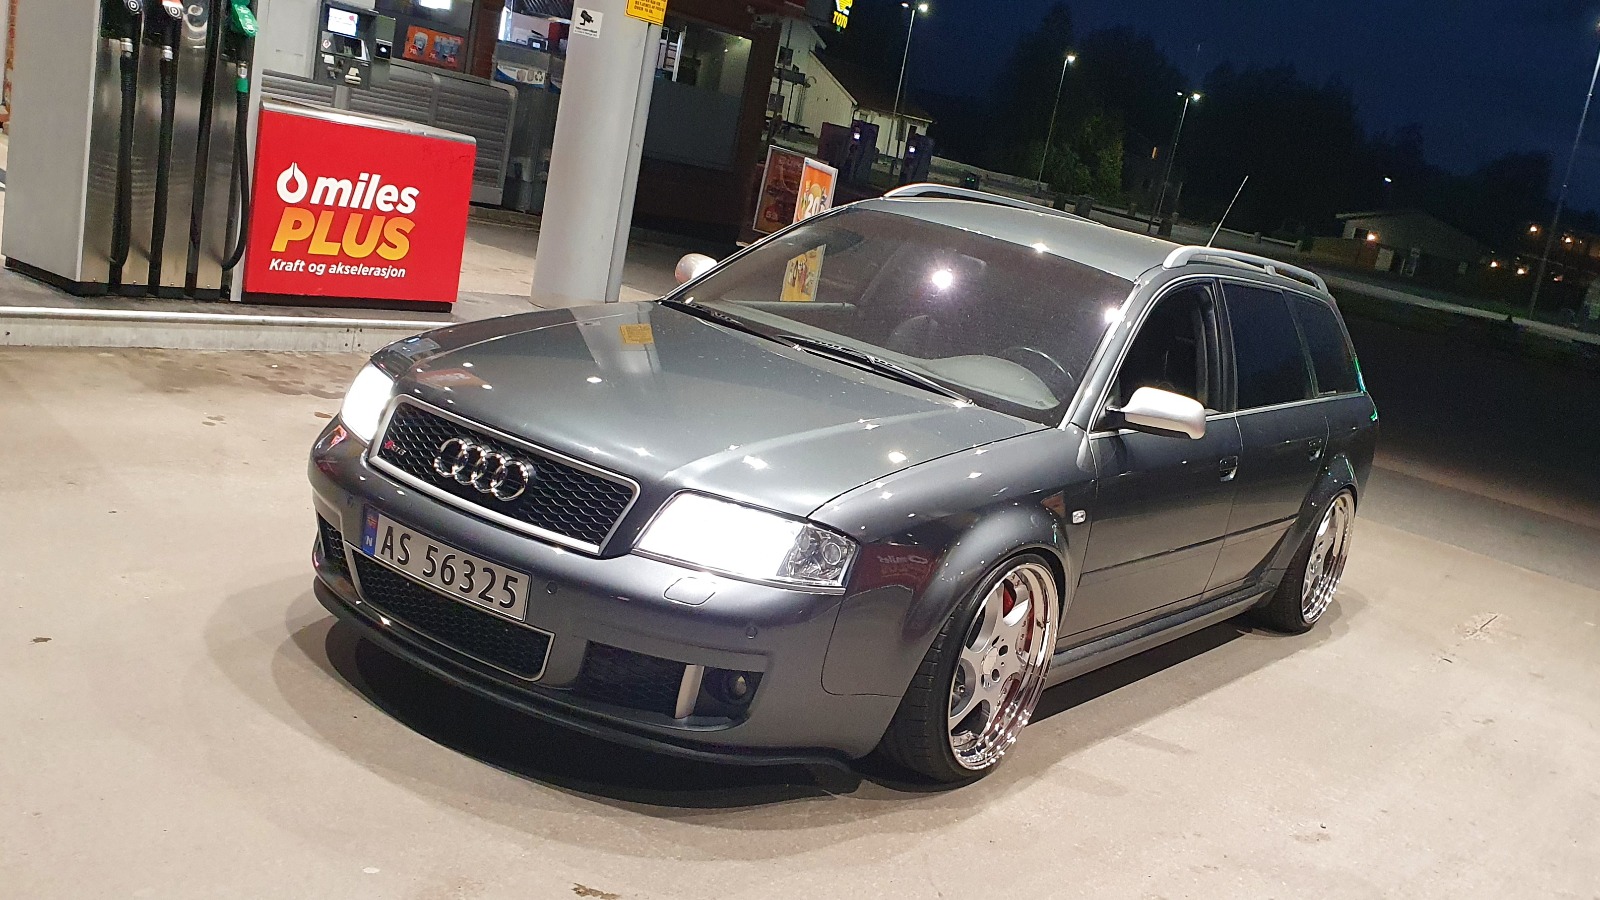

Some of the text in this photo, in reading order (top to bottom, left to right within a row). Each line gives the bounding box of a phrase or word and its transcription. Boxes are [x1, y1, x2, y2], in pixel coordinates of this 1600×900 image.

[309, 172, 420, 214] miles
[270, 206, 416, 260] PLUS
[269, 258, 406, 279] Kraft og akselerasjon
[365, 535, 373, 547] N
[380, 525, 519, 609] AS 56325
